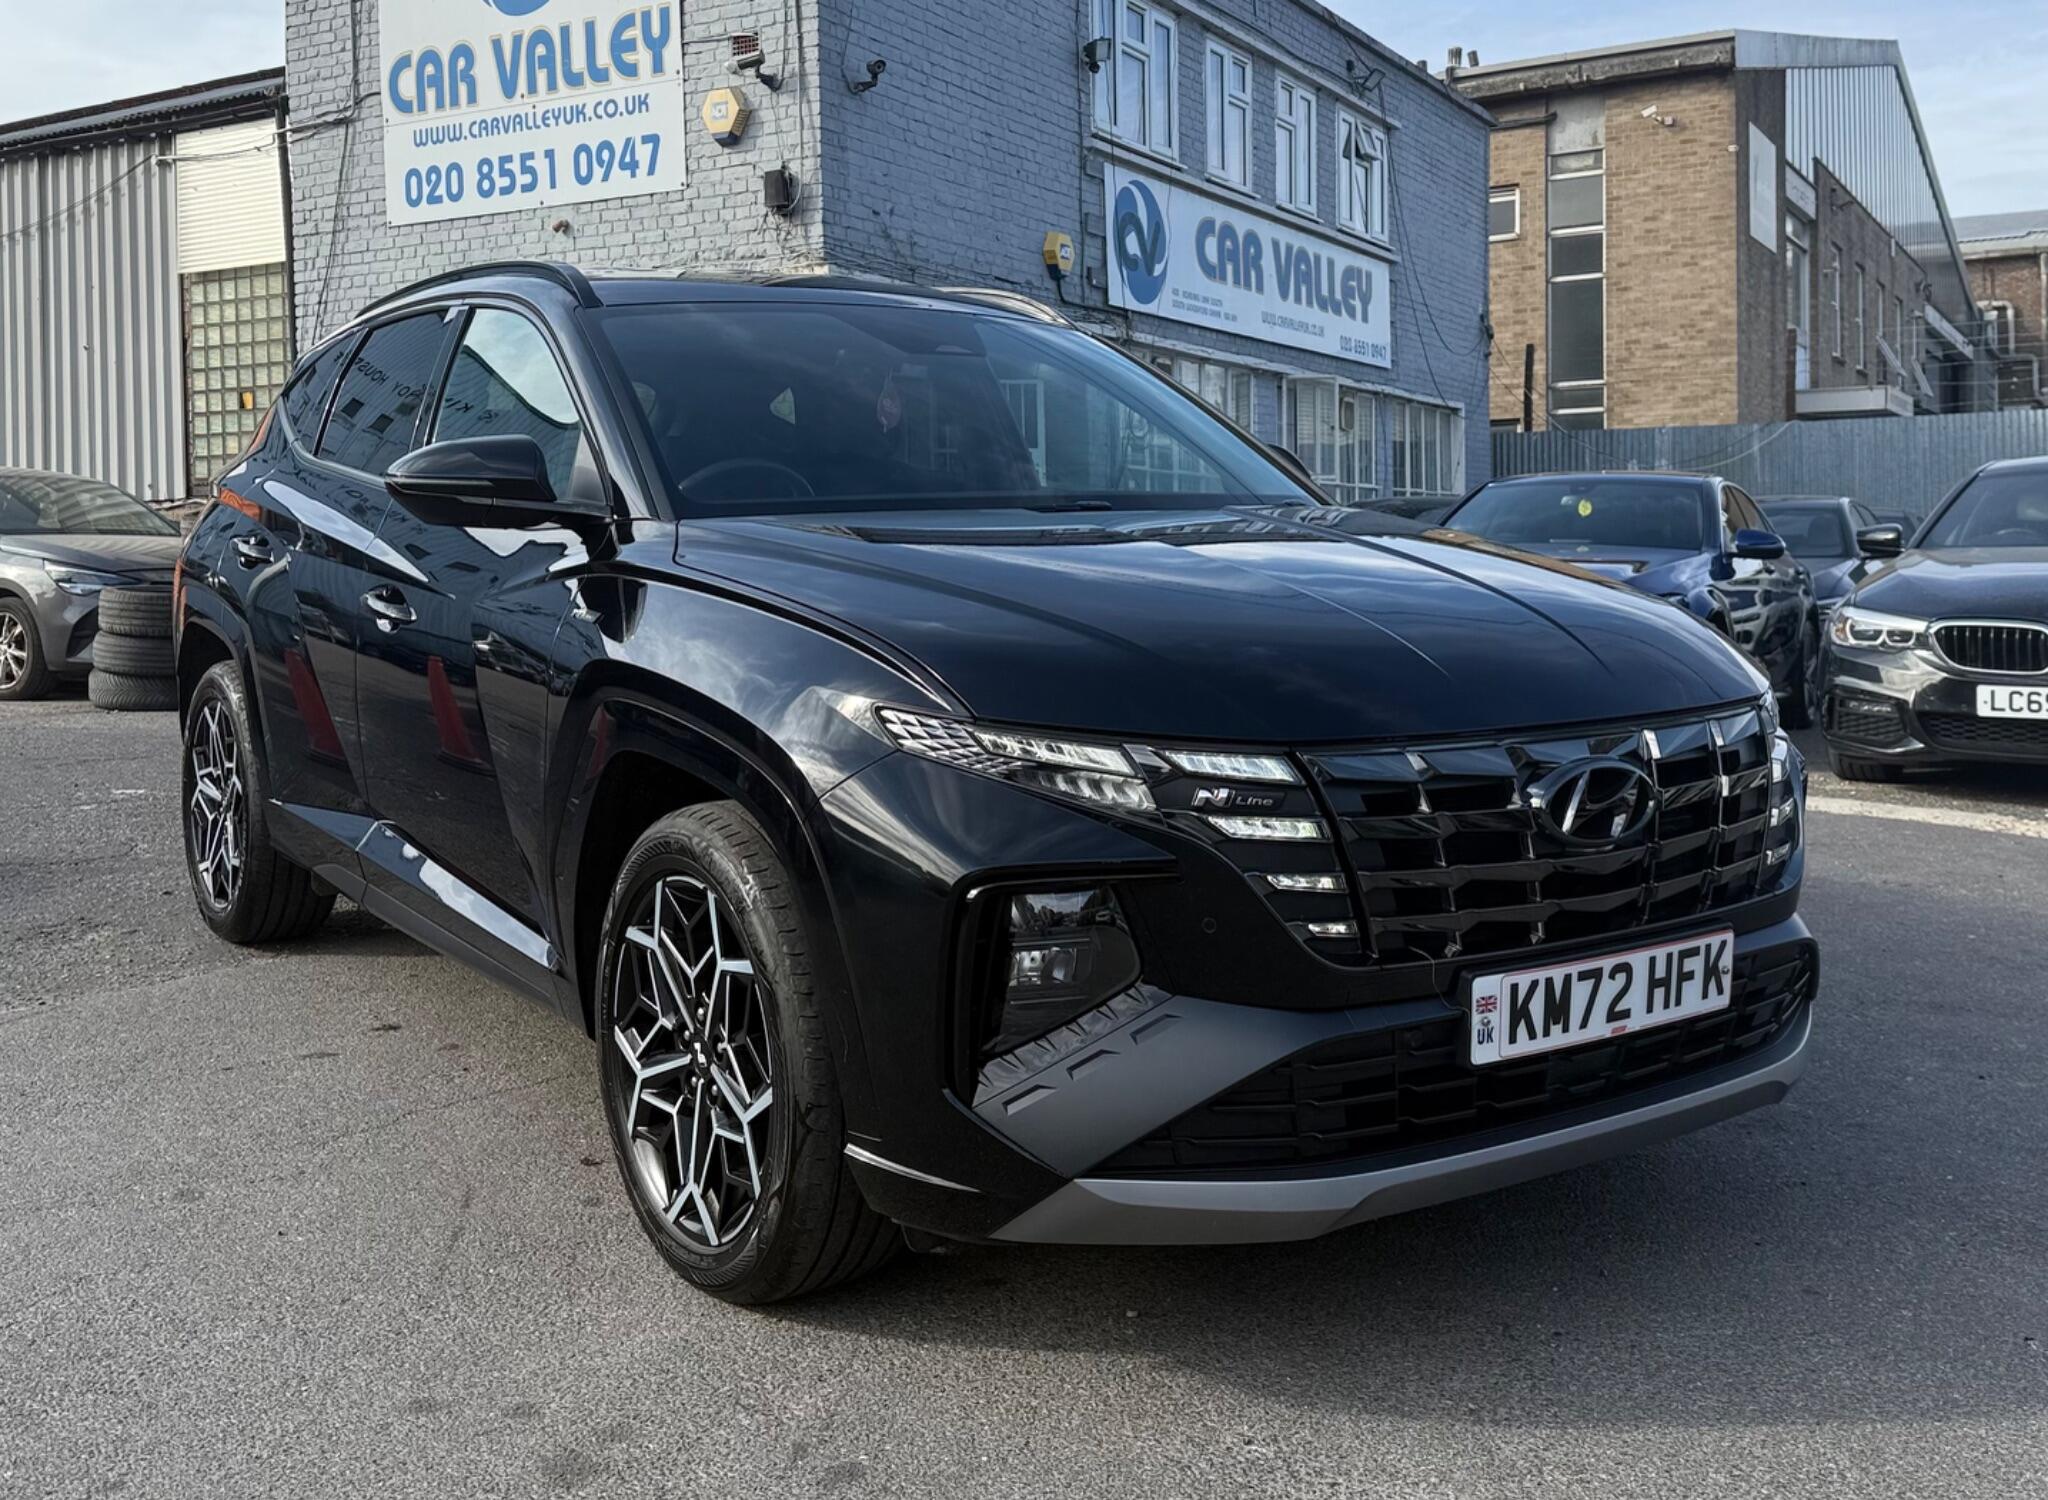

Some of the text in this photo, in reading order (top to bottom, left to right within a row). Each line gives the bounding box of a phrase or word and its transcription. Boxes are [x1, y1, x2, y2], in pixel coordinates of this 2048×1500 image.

[388, 5, 671, 114] CAR VALLEY
[413, 93, 650, 148] WWW.CARVALLEYUK.CO.UK
[404, 133, 661, 208] 020 8551 0947
[1195, 216, 1373, 324] CAR VALLEY
[1990, 689, 2048, 713] LC6
[1508, 939, 1728, 1045] KM72 HFK
[1477, 1026, 1494, 1045] UK
